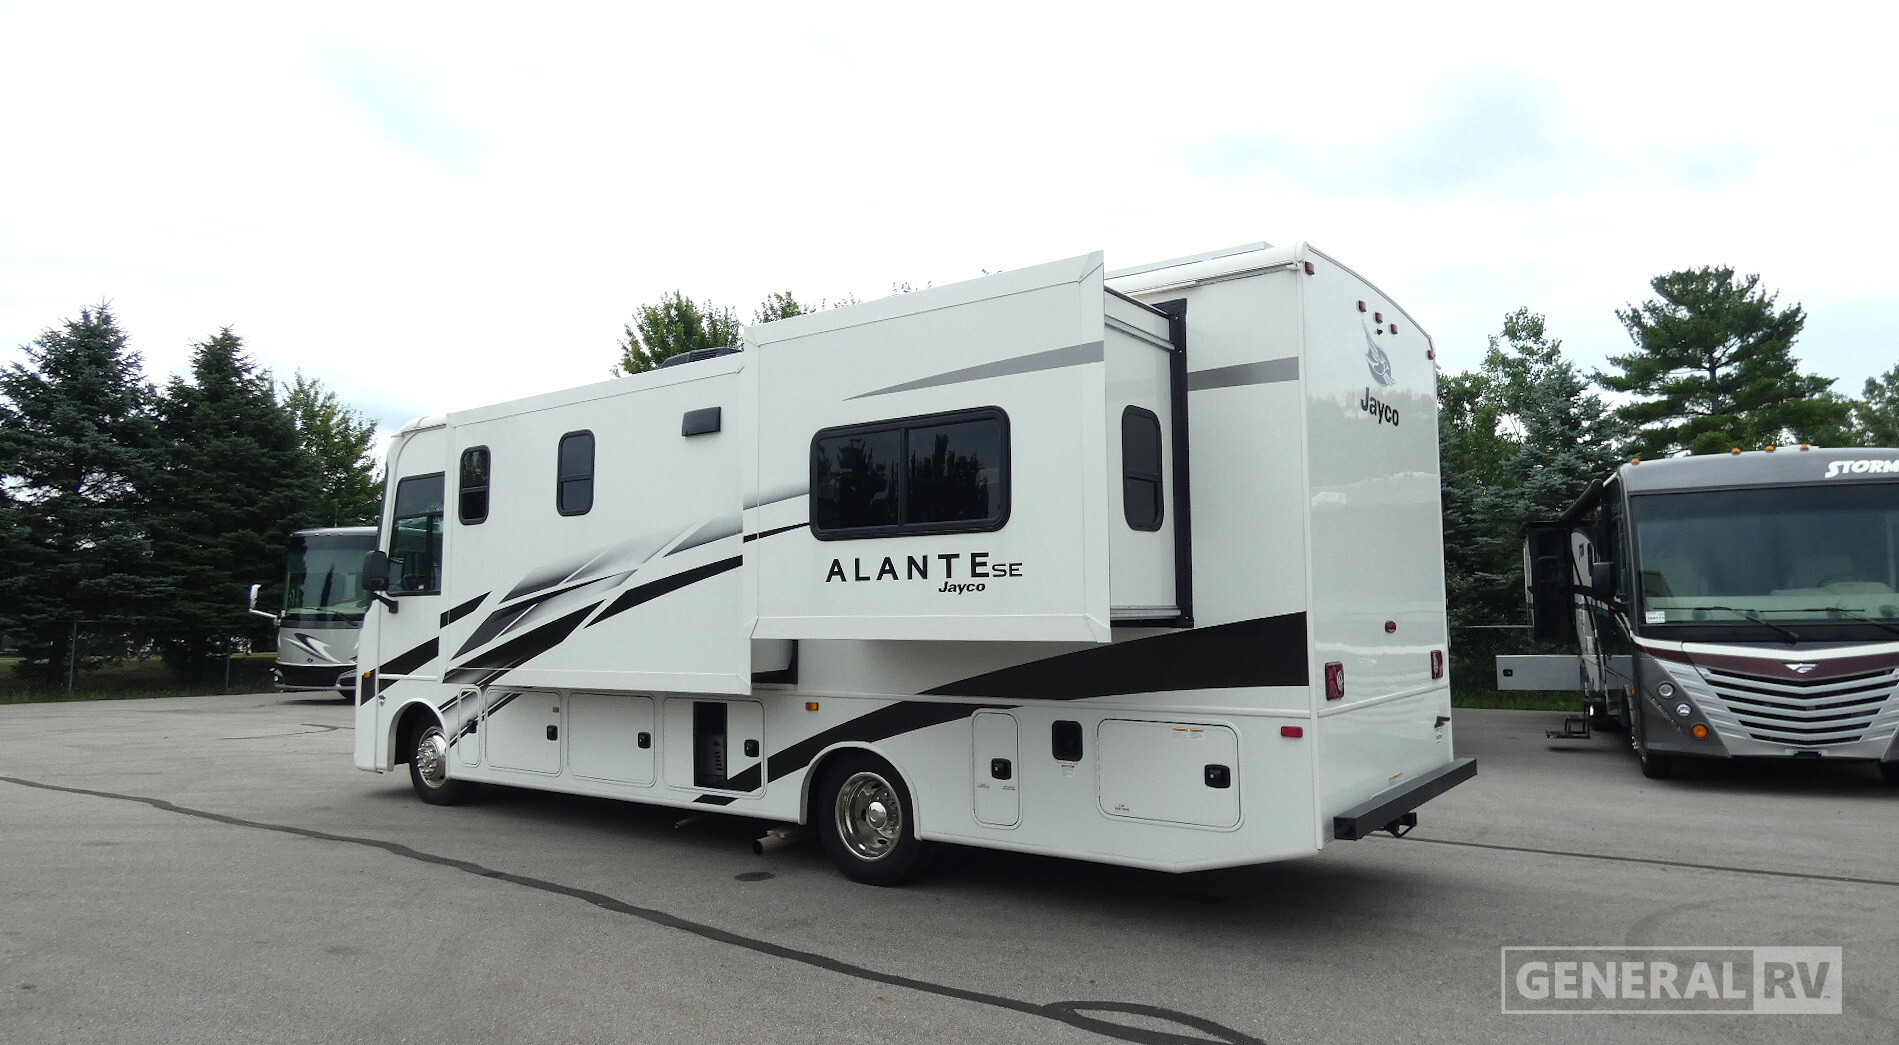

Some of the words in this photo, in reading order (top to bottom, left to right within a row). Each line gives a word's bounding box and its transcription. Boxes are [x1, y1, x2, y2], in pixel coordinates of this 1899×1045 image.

[1361, 386, 1399, 426] Jayco
[825, 552, 989, 582] ALANTE
[992, 562, 1023, 577] SE
[938, 581, 986, 595] Jayco
